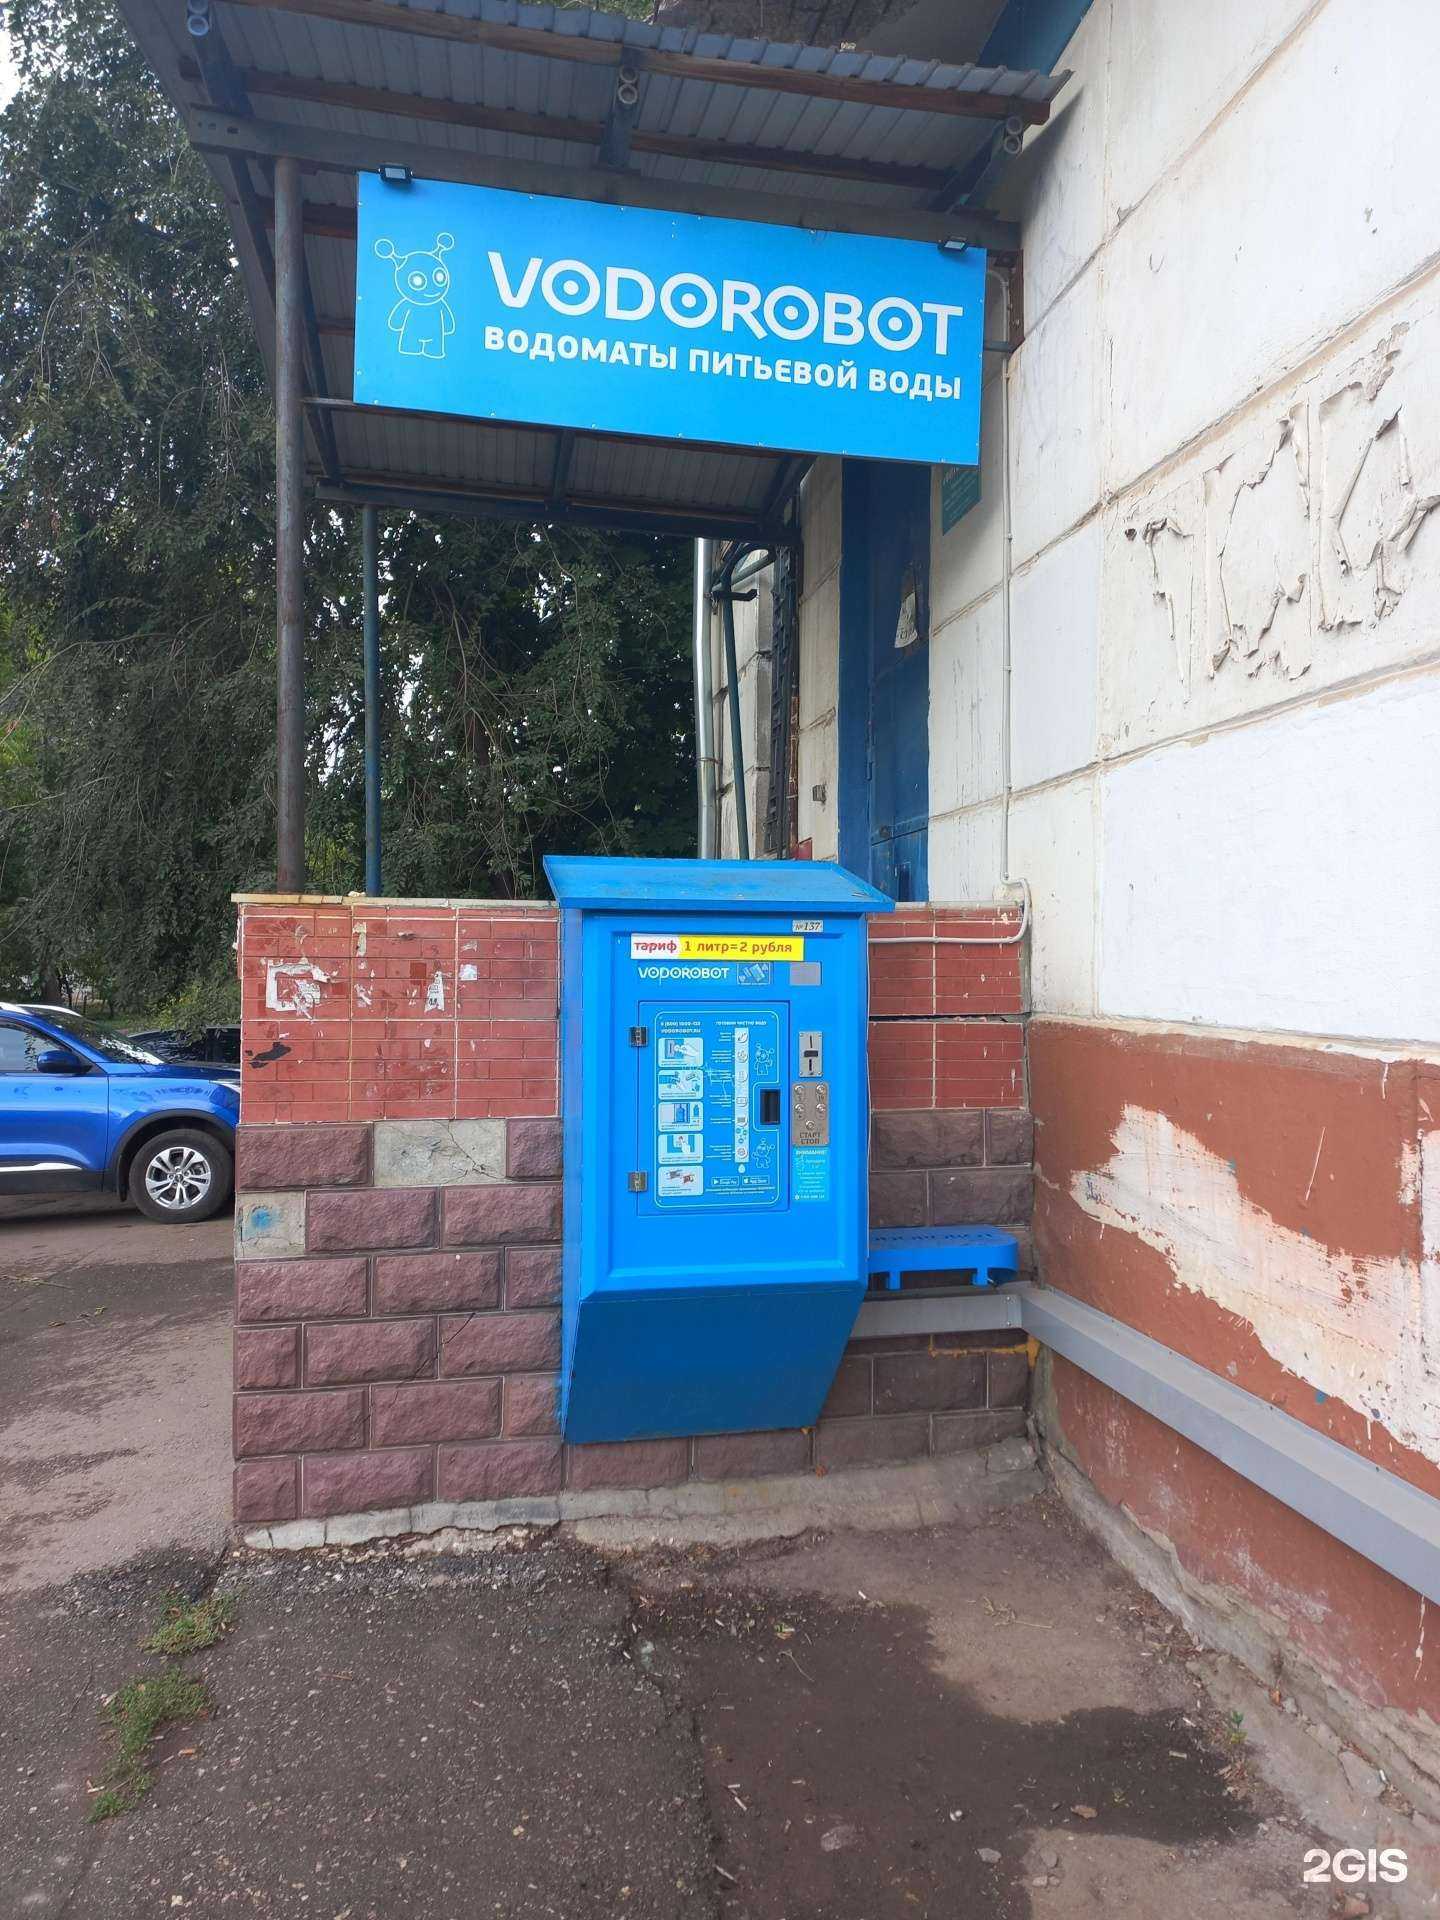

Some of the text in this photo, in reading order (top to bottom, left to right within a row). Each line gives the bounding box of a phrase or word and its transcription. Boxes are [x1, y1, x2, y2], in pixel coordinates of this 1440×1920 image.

[487, 251, 963, 355] VODOROBOT
[484, 325, 962, 402] ВОДОМАТЫ ПИТЬЕВОЙ ВОДЫ
[634, 940, 677, 954] тариф
[684, 941, 692, 952] 1
[751, 941, 792, 955] рубля
[638, 966, 730, 980] VODOROBOT
